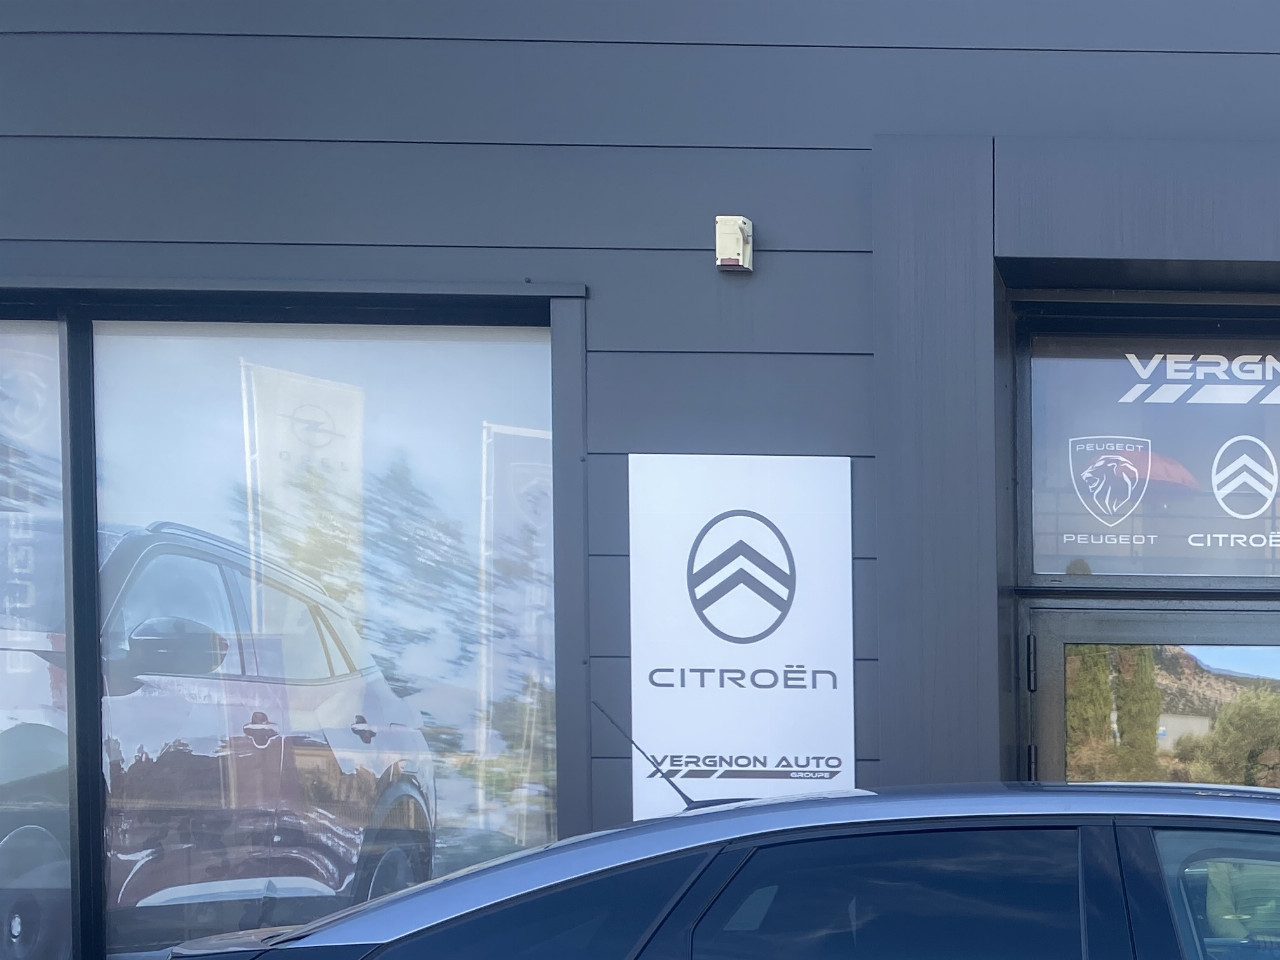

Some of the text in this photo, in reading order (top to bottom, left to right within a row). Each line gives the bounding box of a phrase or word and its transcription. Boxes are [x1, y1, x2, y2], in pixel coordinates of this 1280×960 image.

[1075, 443, 1145, 453] PEUGEOT
[1063, 534, 1158, 545] PEUGEOT
[650, 754, 842, 769] VERGNON AUTO
